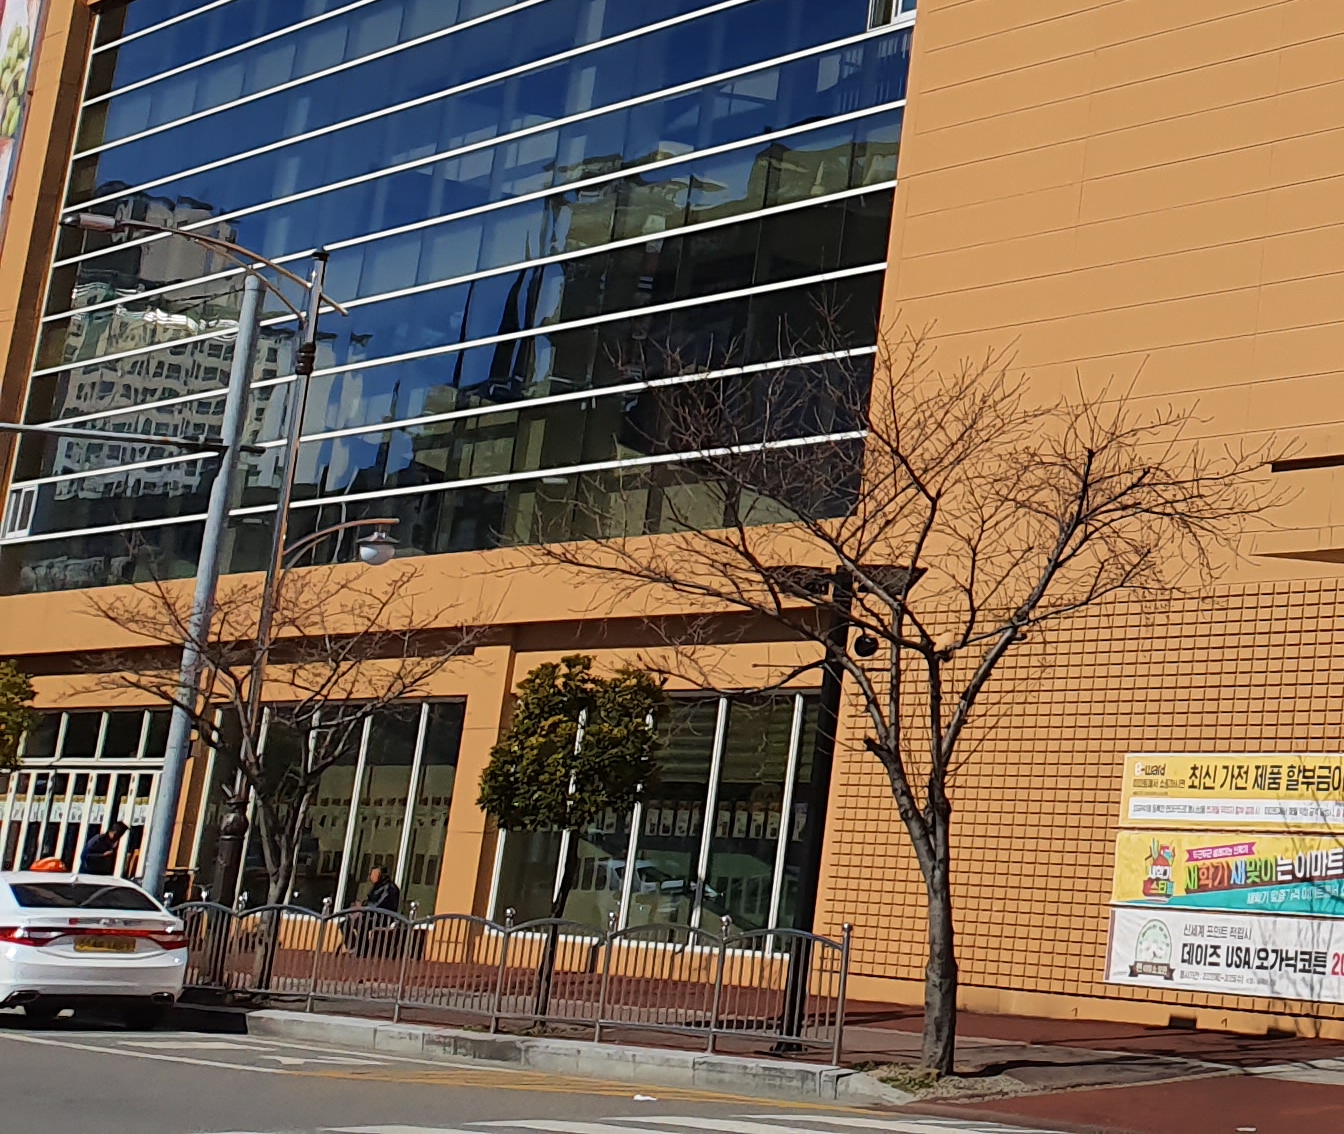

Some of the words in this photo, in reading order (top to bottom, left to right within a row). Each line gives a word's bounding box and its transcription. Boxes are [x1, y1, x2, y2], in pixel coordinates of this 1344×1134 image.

[1187, 764, 1218, 791] 최신
[1220, 764, 1250, 791] 가전
[1252, 764, 1283, 792] 제품
[1183, 923, 1205, 938] 신세계
[1181, 942, 1222, 967] 데이즈
